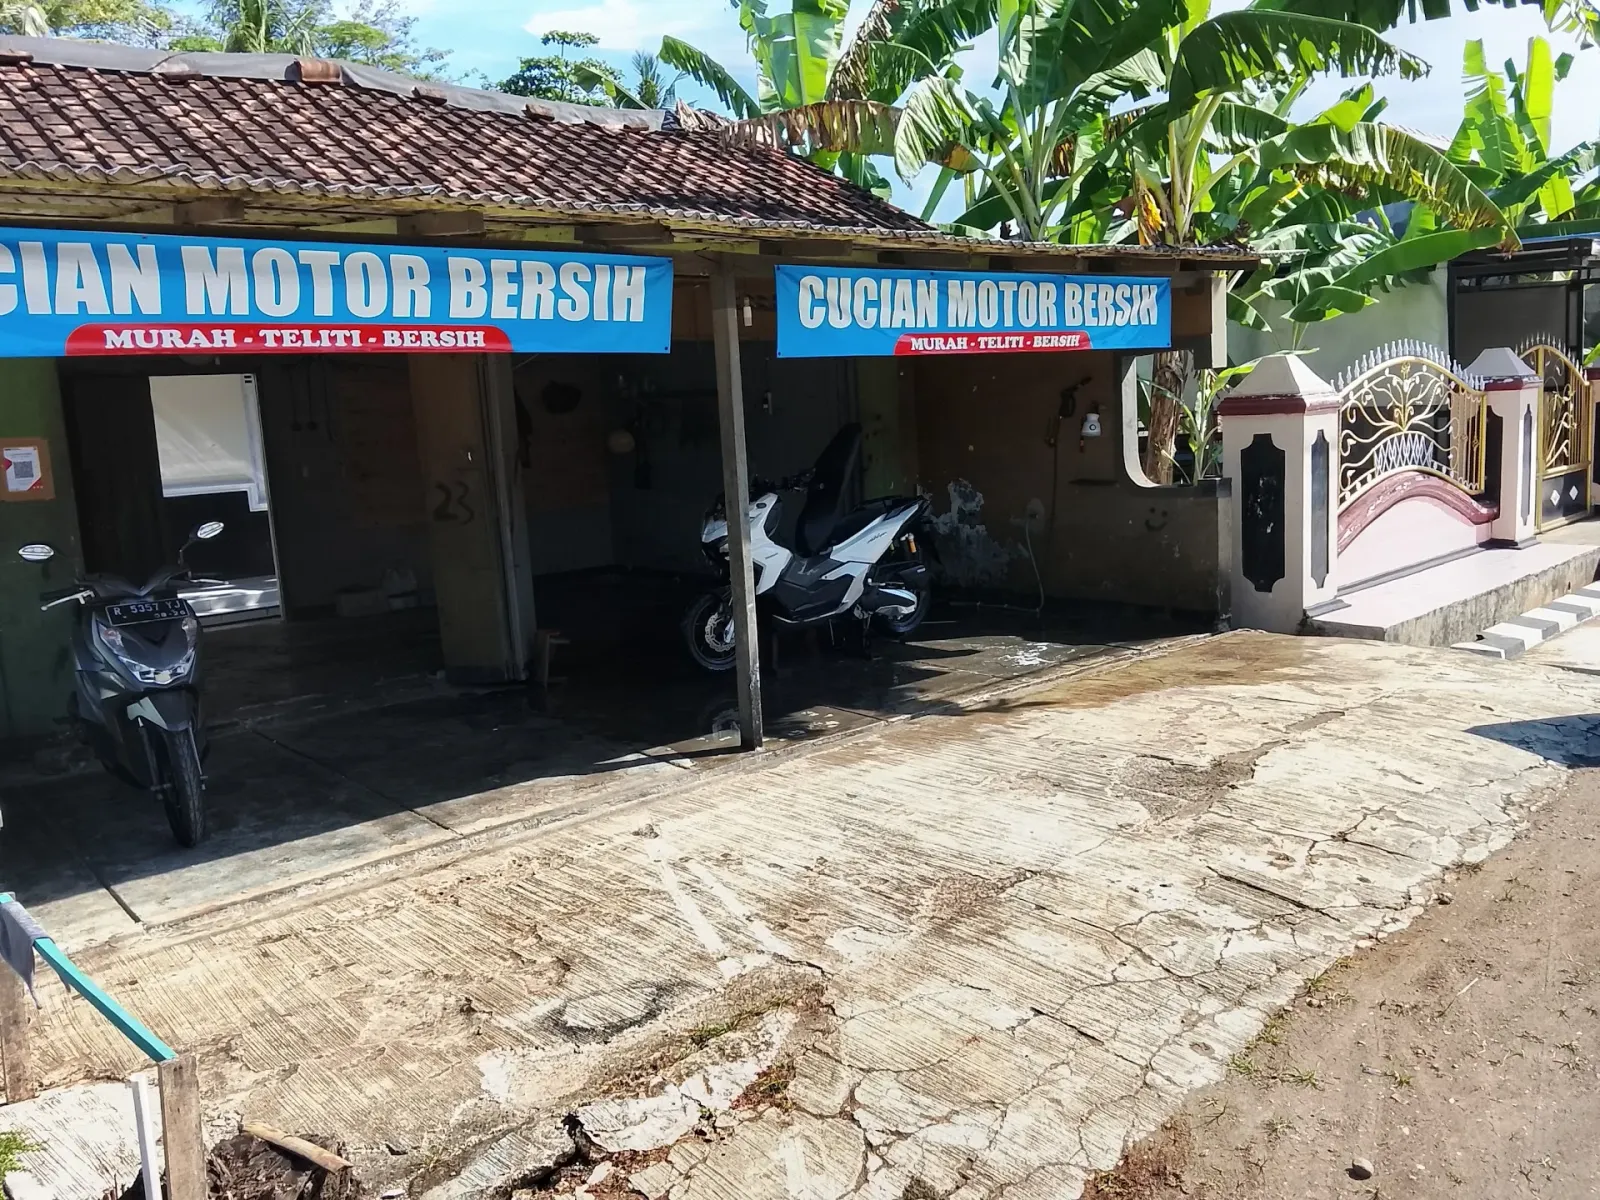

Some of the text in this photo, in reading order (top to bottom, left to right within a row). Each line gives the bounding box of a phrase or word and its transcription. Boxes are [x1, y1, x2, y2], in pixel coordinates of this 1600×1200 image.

[0, 241, 647, 322] IAN MOTOR BERSIH
[798, 275, 1158, 329] CUCIAN MOTOR BERSIH
[103, 329, 237, 349] MURAH
[258, 329, 363, 348] TELITI
[382, 330, 487, 348] BERSIH
[910, 337, 968, 351] MURAH
[977, 335, 1025, 349] TELITI
[1032, 334, 1080, 348] BERSIH
[433, 480, 475, 526] 23
[113, 600, 181, 616] R 5357 YJ
